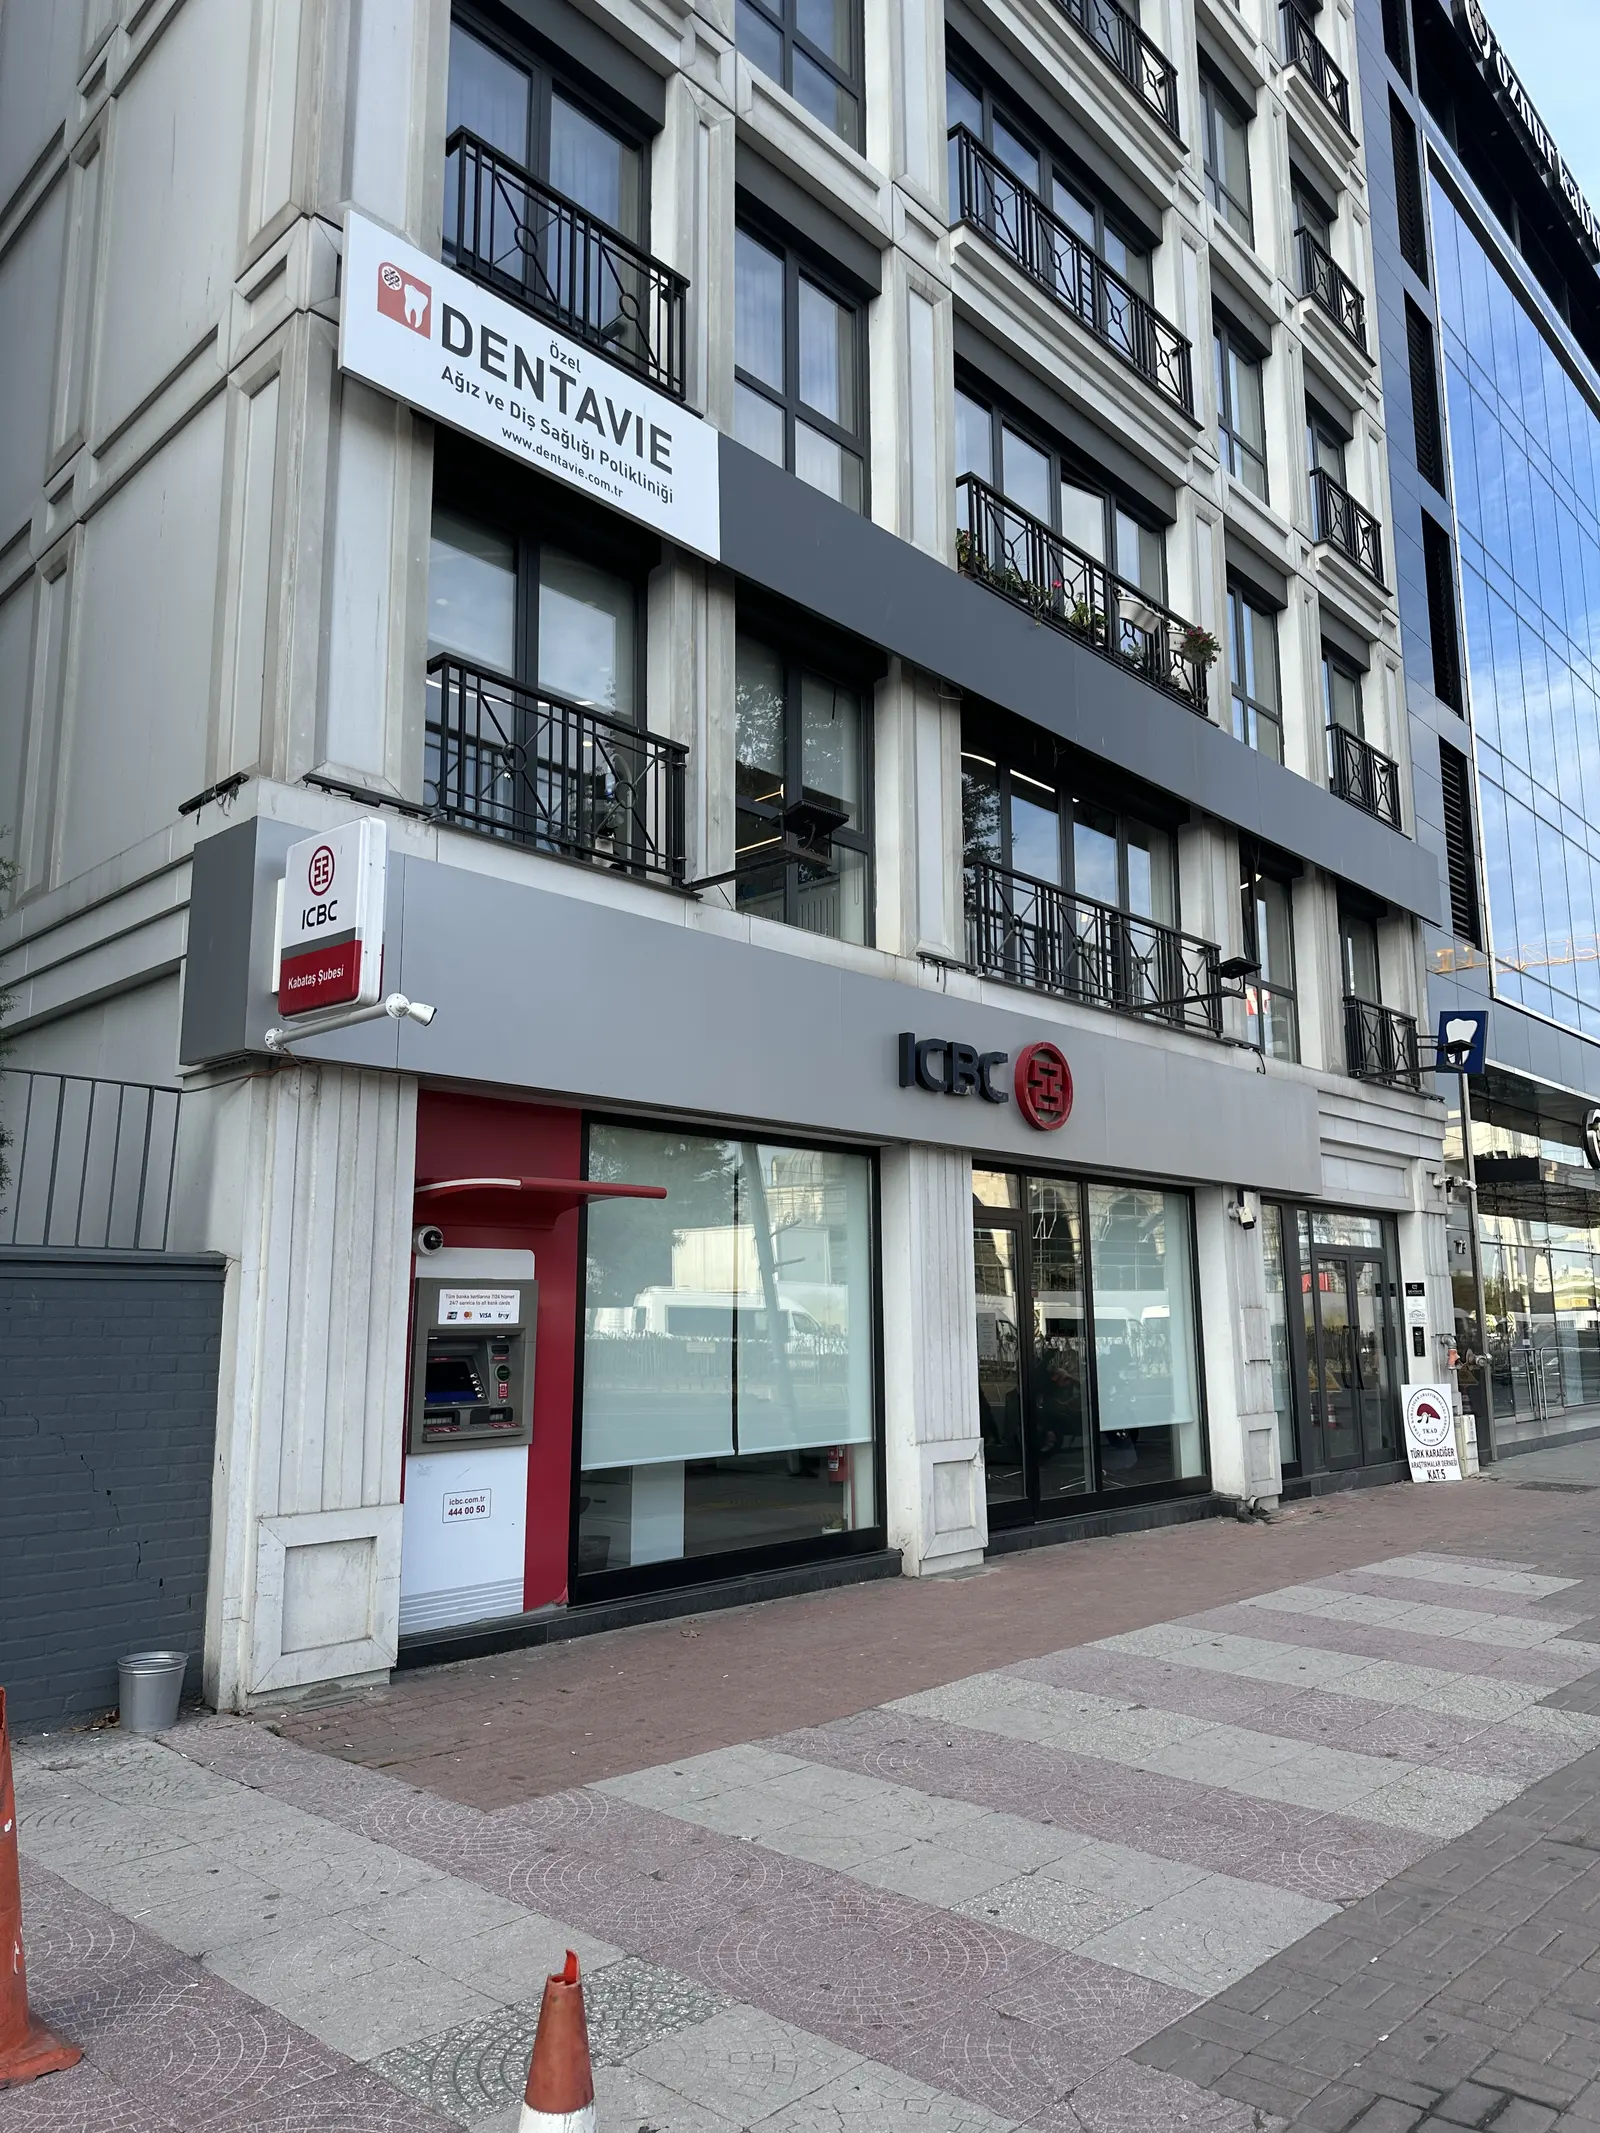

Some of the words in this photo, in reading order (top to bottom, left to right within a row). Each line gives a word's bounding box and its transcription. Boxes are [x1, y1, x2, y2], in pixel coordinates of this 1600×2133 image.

[549, 340, 582, 374] Özel
[441, 302, 673, 476] DENTAVIE
[441, 365, 480, 400] Ağız
[485, 390, 505, 411] ve
[510, 400, 537, 430] Diş
[541, 418, 595, 463] Sağlığı
[600, 449, 674, 505] Polikliniği
[501, 427, 624, 499] www.dentavie.com.tr
[301, 900, 338, 930] ICBC
[288, 971, 316, 990] Kabataş
[318, 964, 344, 985] Şubesi
[898, 1032, 1009, 1104] ICBC
[1410, 1448, 1425, 1459] TÜRK
[448, 1508, 463, 1516] 444
[464, 1506, 474, 1514] 00
[476, 1505, 486, 1513] 50
[449, 1496, 486, 1506] icbc.com.tr
